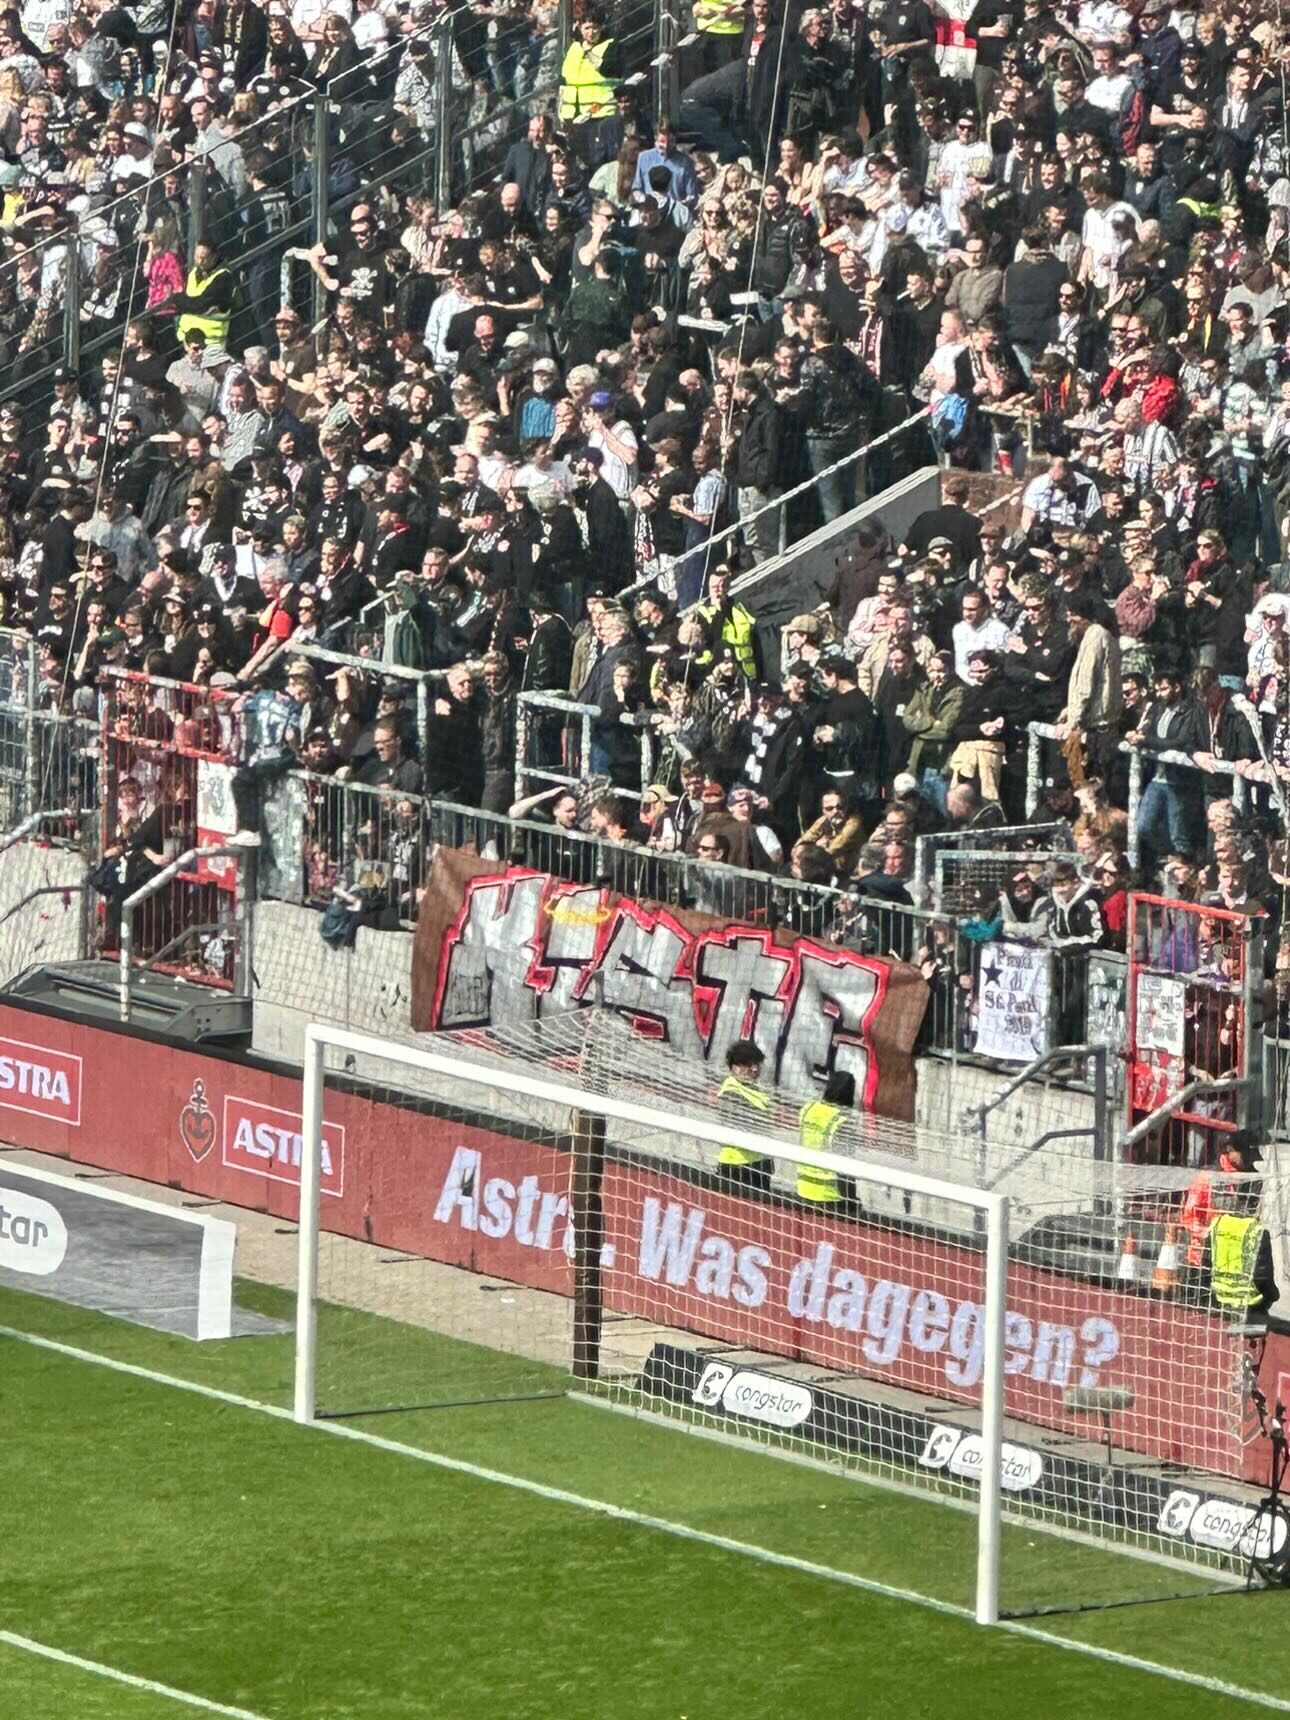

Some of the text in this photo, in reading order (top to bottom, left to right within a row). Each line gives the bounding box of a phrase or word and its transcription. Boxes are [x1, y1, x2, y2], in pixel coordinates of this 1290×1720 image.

[638, 1196, 772, 1307] Was
[786, 1240, 1120, 1389] dagegen?
[735, 1385, 803, 1413] congstar
[962, 1449, 1031, 1477] cotar
